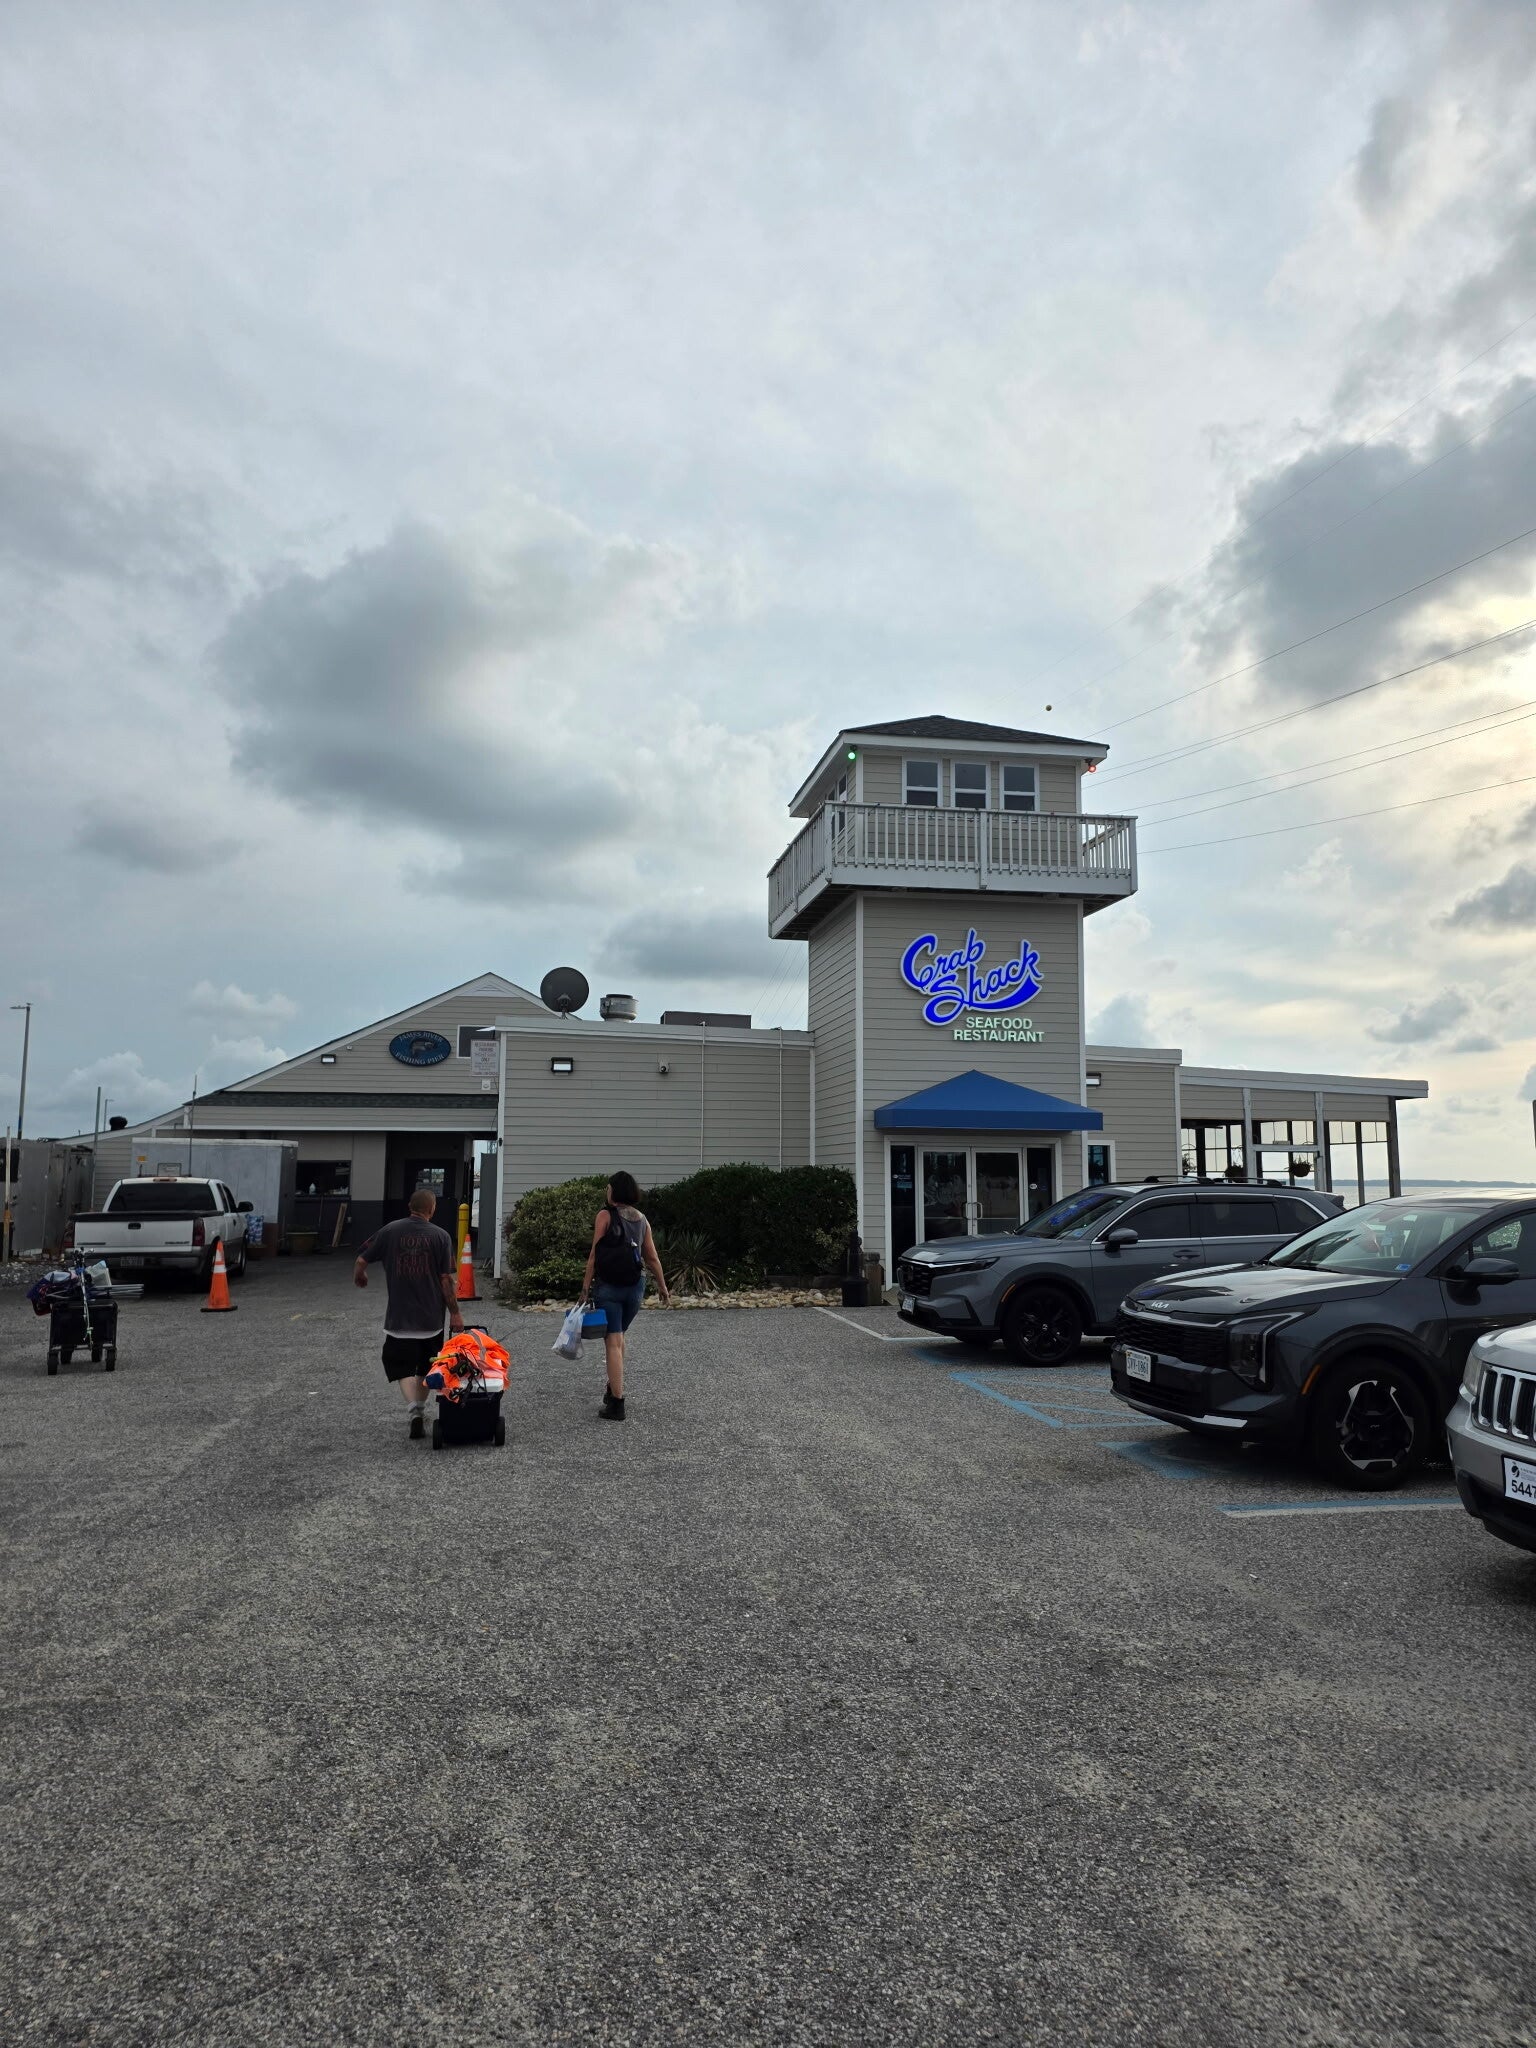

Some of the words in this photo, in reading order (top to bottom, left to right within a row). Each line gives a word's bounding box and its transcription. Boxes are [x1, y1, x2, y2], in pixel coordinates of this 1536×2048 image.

[901, 927, 986, 994] Crab
[922, 939, 1043, 1026] Shack
[966, 1016, 1033, 1030] SEAFOOD
[423, 1032, 443, 1043] RIVER
[953, 1029, 1045, 1043] RESTAURANT
[395, 1052, 427, 1065] FISHING
[427, 1054, 445, 1064] PIER
